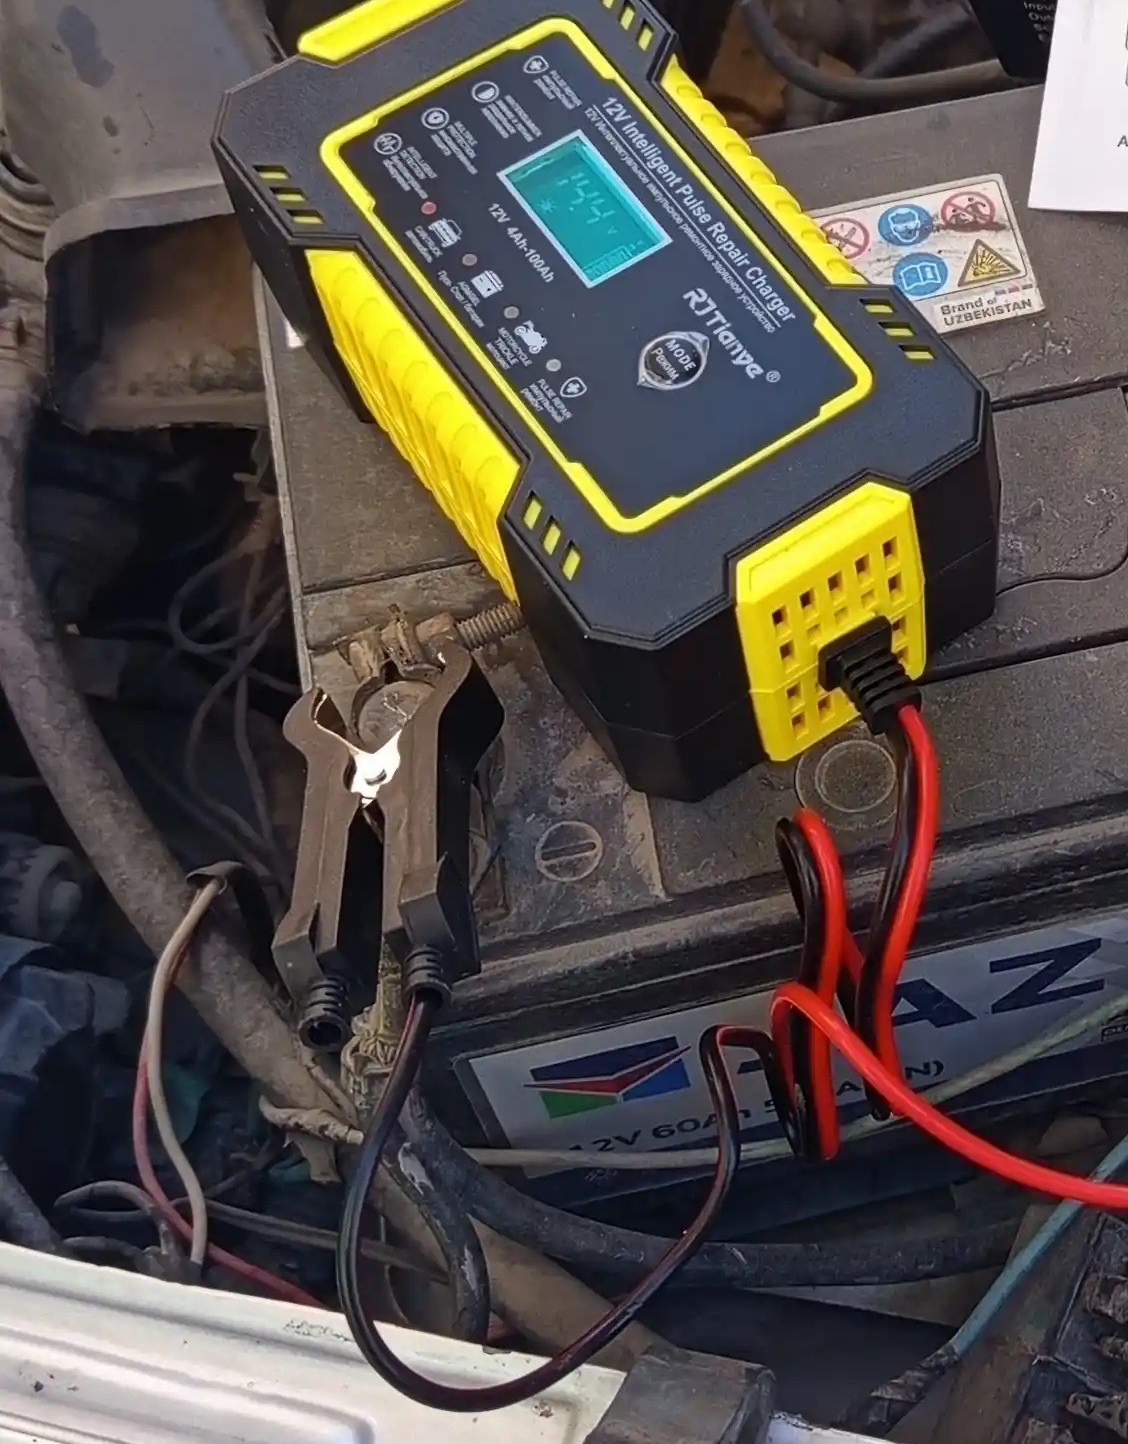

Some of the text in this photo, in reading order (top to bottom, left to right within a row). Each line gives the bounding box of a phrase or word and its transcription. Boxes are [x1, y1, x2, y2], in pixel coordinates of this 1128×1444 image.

[600, 96, 798, 324] 12V Intelligent Pulse Repair Charger
[486, 202, 556, 282] 12V 4Ah-100Ah
[940, 296, 998, 316] Brand of
[943, 298, 1032, 327] UZBEKISTAN
[649, 346, 682, 379] Режим
[664, 338, 696, 372] MODE
